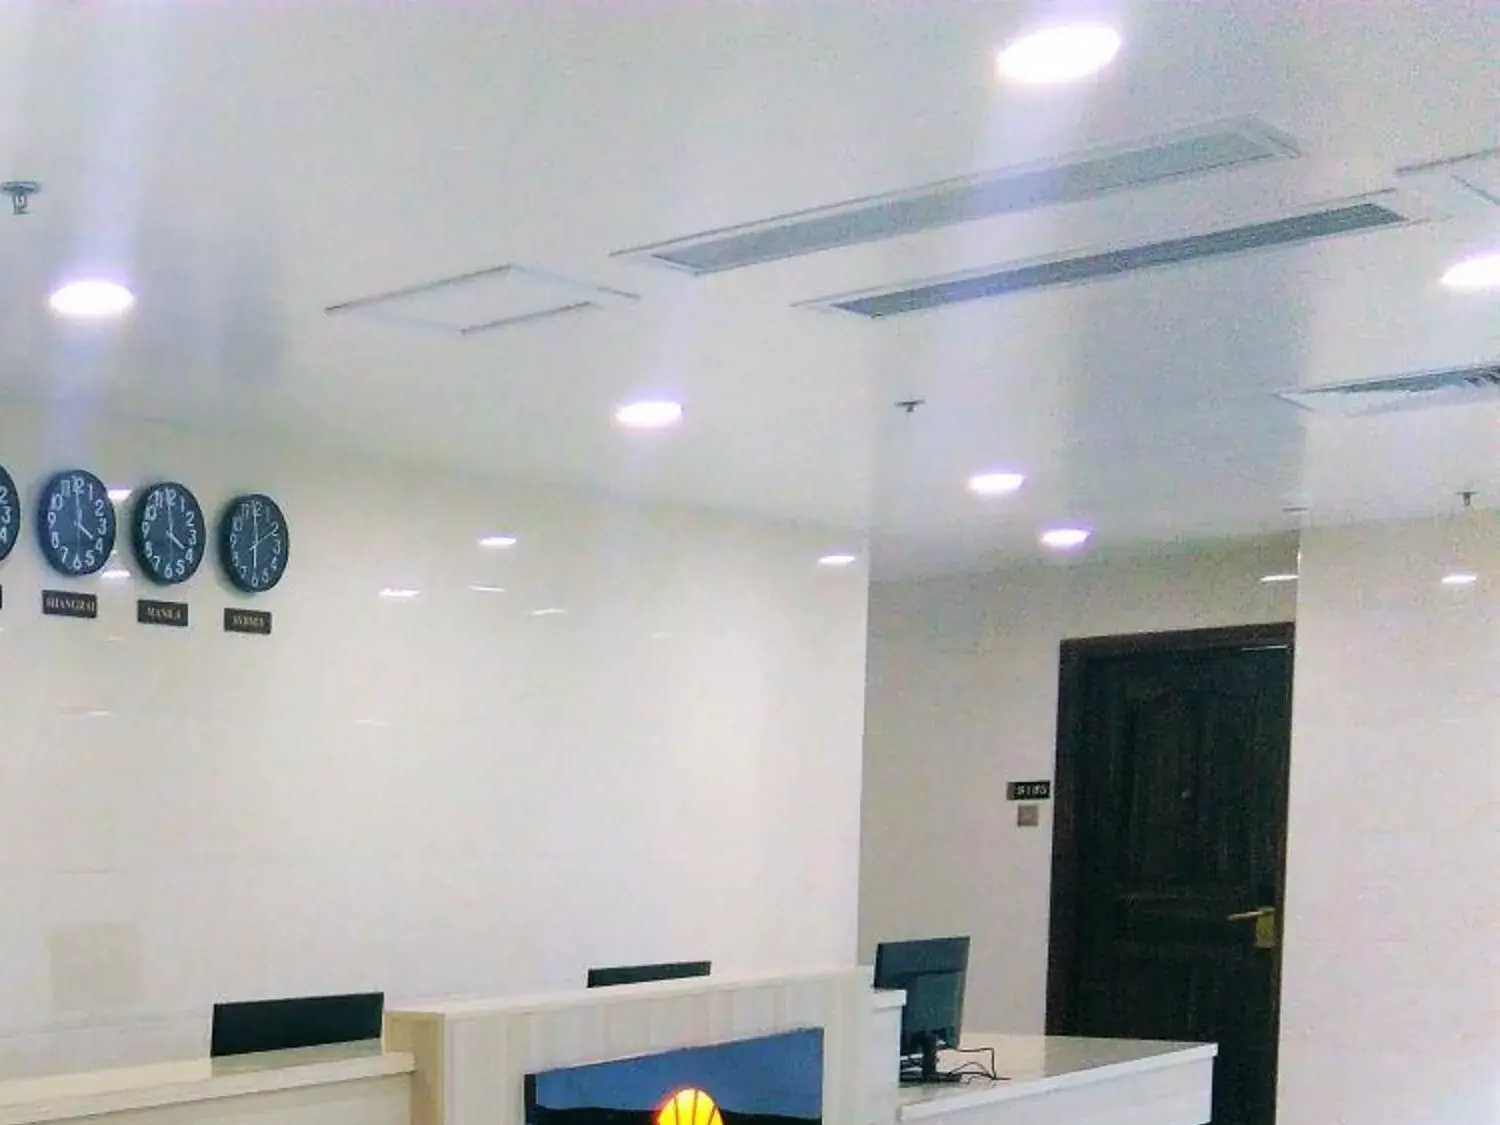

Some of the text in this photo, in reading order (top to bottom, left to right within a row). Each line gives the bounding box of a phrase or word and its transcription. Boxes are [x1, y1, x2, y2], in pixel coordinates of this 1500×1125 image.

[1, 506, 12, 524] 3
[0, 526, 8, 542] 4
[147, 606, 181, 619] MANILA
